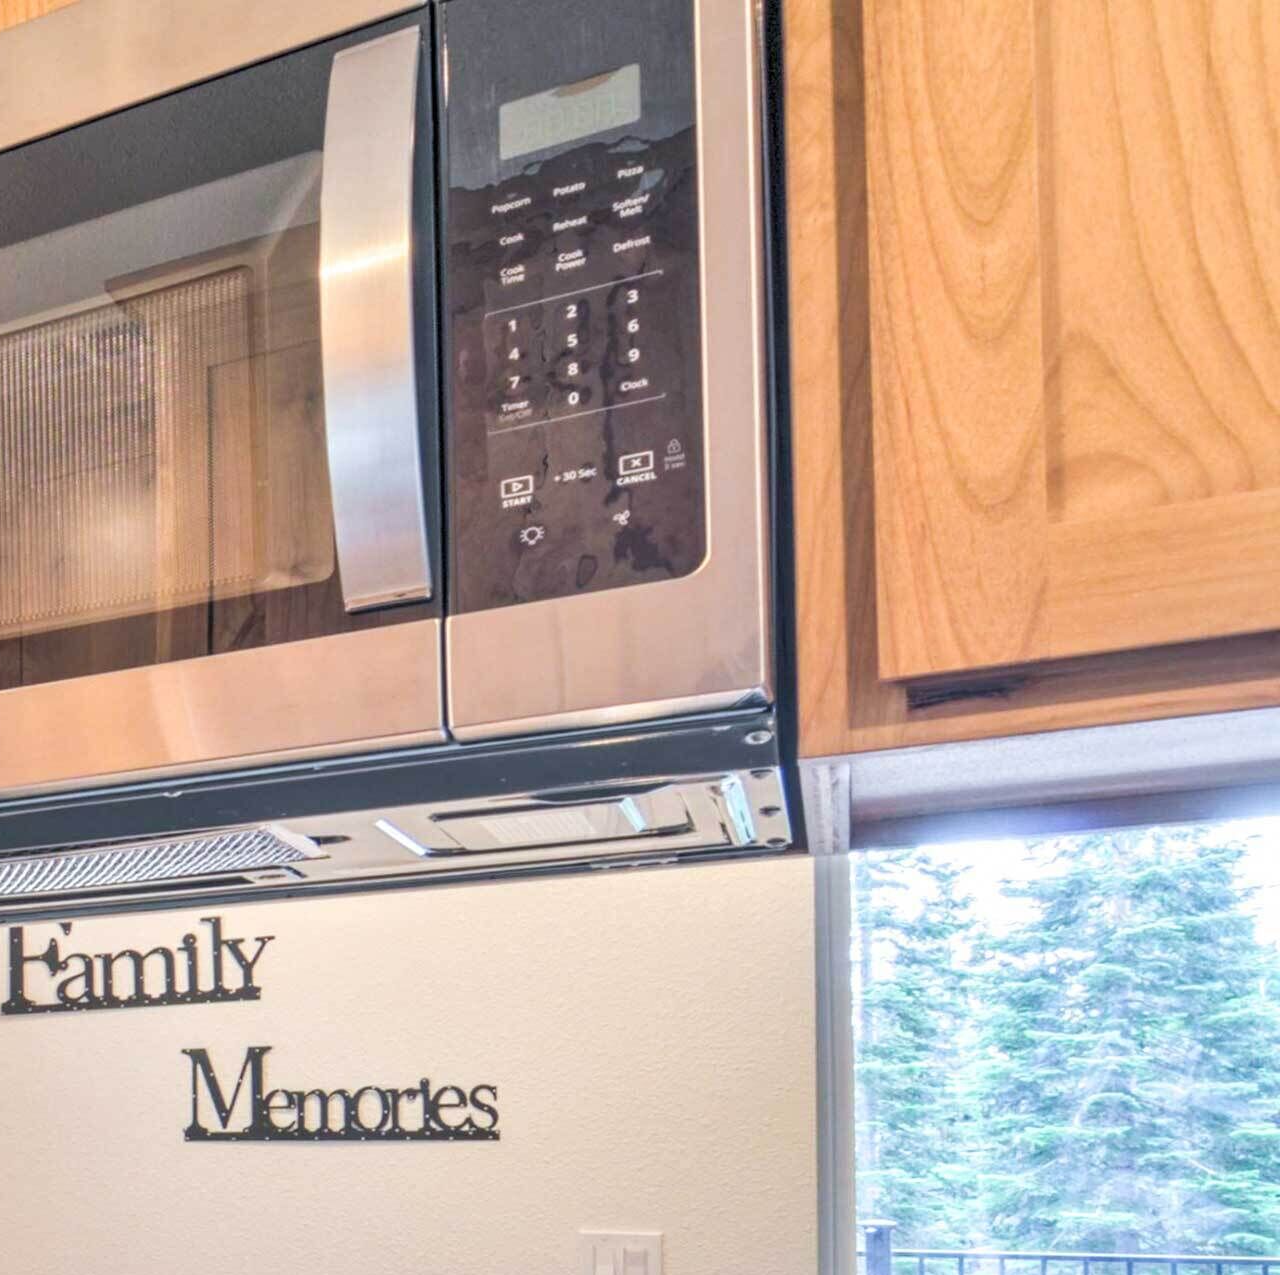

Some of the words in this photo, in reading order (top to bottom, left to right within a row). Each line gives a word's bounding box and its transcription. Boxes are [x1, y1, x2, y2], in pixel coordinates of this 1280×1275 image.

[617, 165, 644, 179] Pizza
[553, 182, 586, 197] Potato
[492, 197, 532, 214] Popcorn
[619, 205, 643, 218] Melt
[553, 216, 588, 232] Reheat
[499, 233, 525, 246] Cook
[613, 236, 651, 253] Defrost
[558, 249, 584, 262] Cook
[500, 264, 526, 277] Cook
[555, 257, 587, 272] Power
[501, 273, 526, 287] Time
[627, 289, 639, 304] 3
[566, 305, 578, 319] 2
[508, 320, 517, 332] 1
[627, 319, 640, 333] 6
[567, 334, 578, 348] 5
[508, 347, 520, 361] 4
[628, 349, 640, 363] 9
[567, 363, 579, 376] 8
[510, 376, 521, 389] 7
[619, 378, 648, 392] Clock
[568, 392, 579, 405] 0
[501, 400, 530, 412] Timer
[563, 471, 577, 483] 30
[578, 467, 598, 479] Sec
[616, 473, 657, 486] CANCEL
[502, 496, 532, 509] START
[1, 917, 276, 1015] Family
[181, 1046, 501, 1142] Memories
